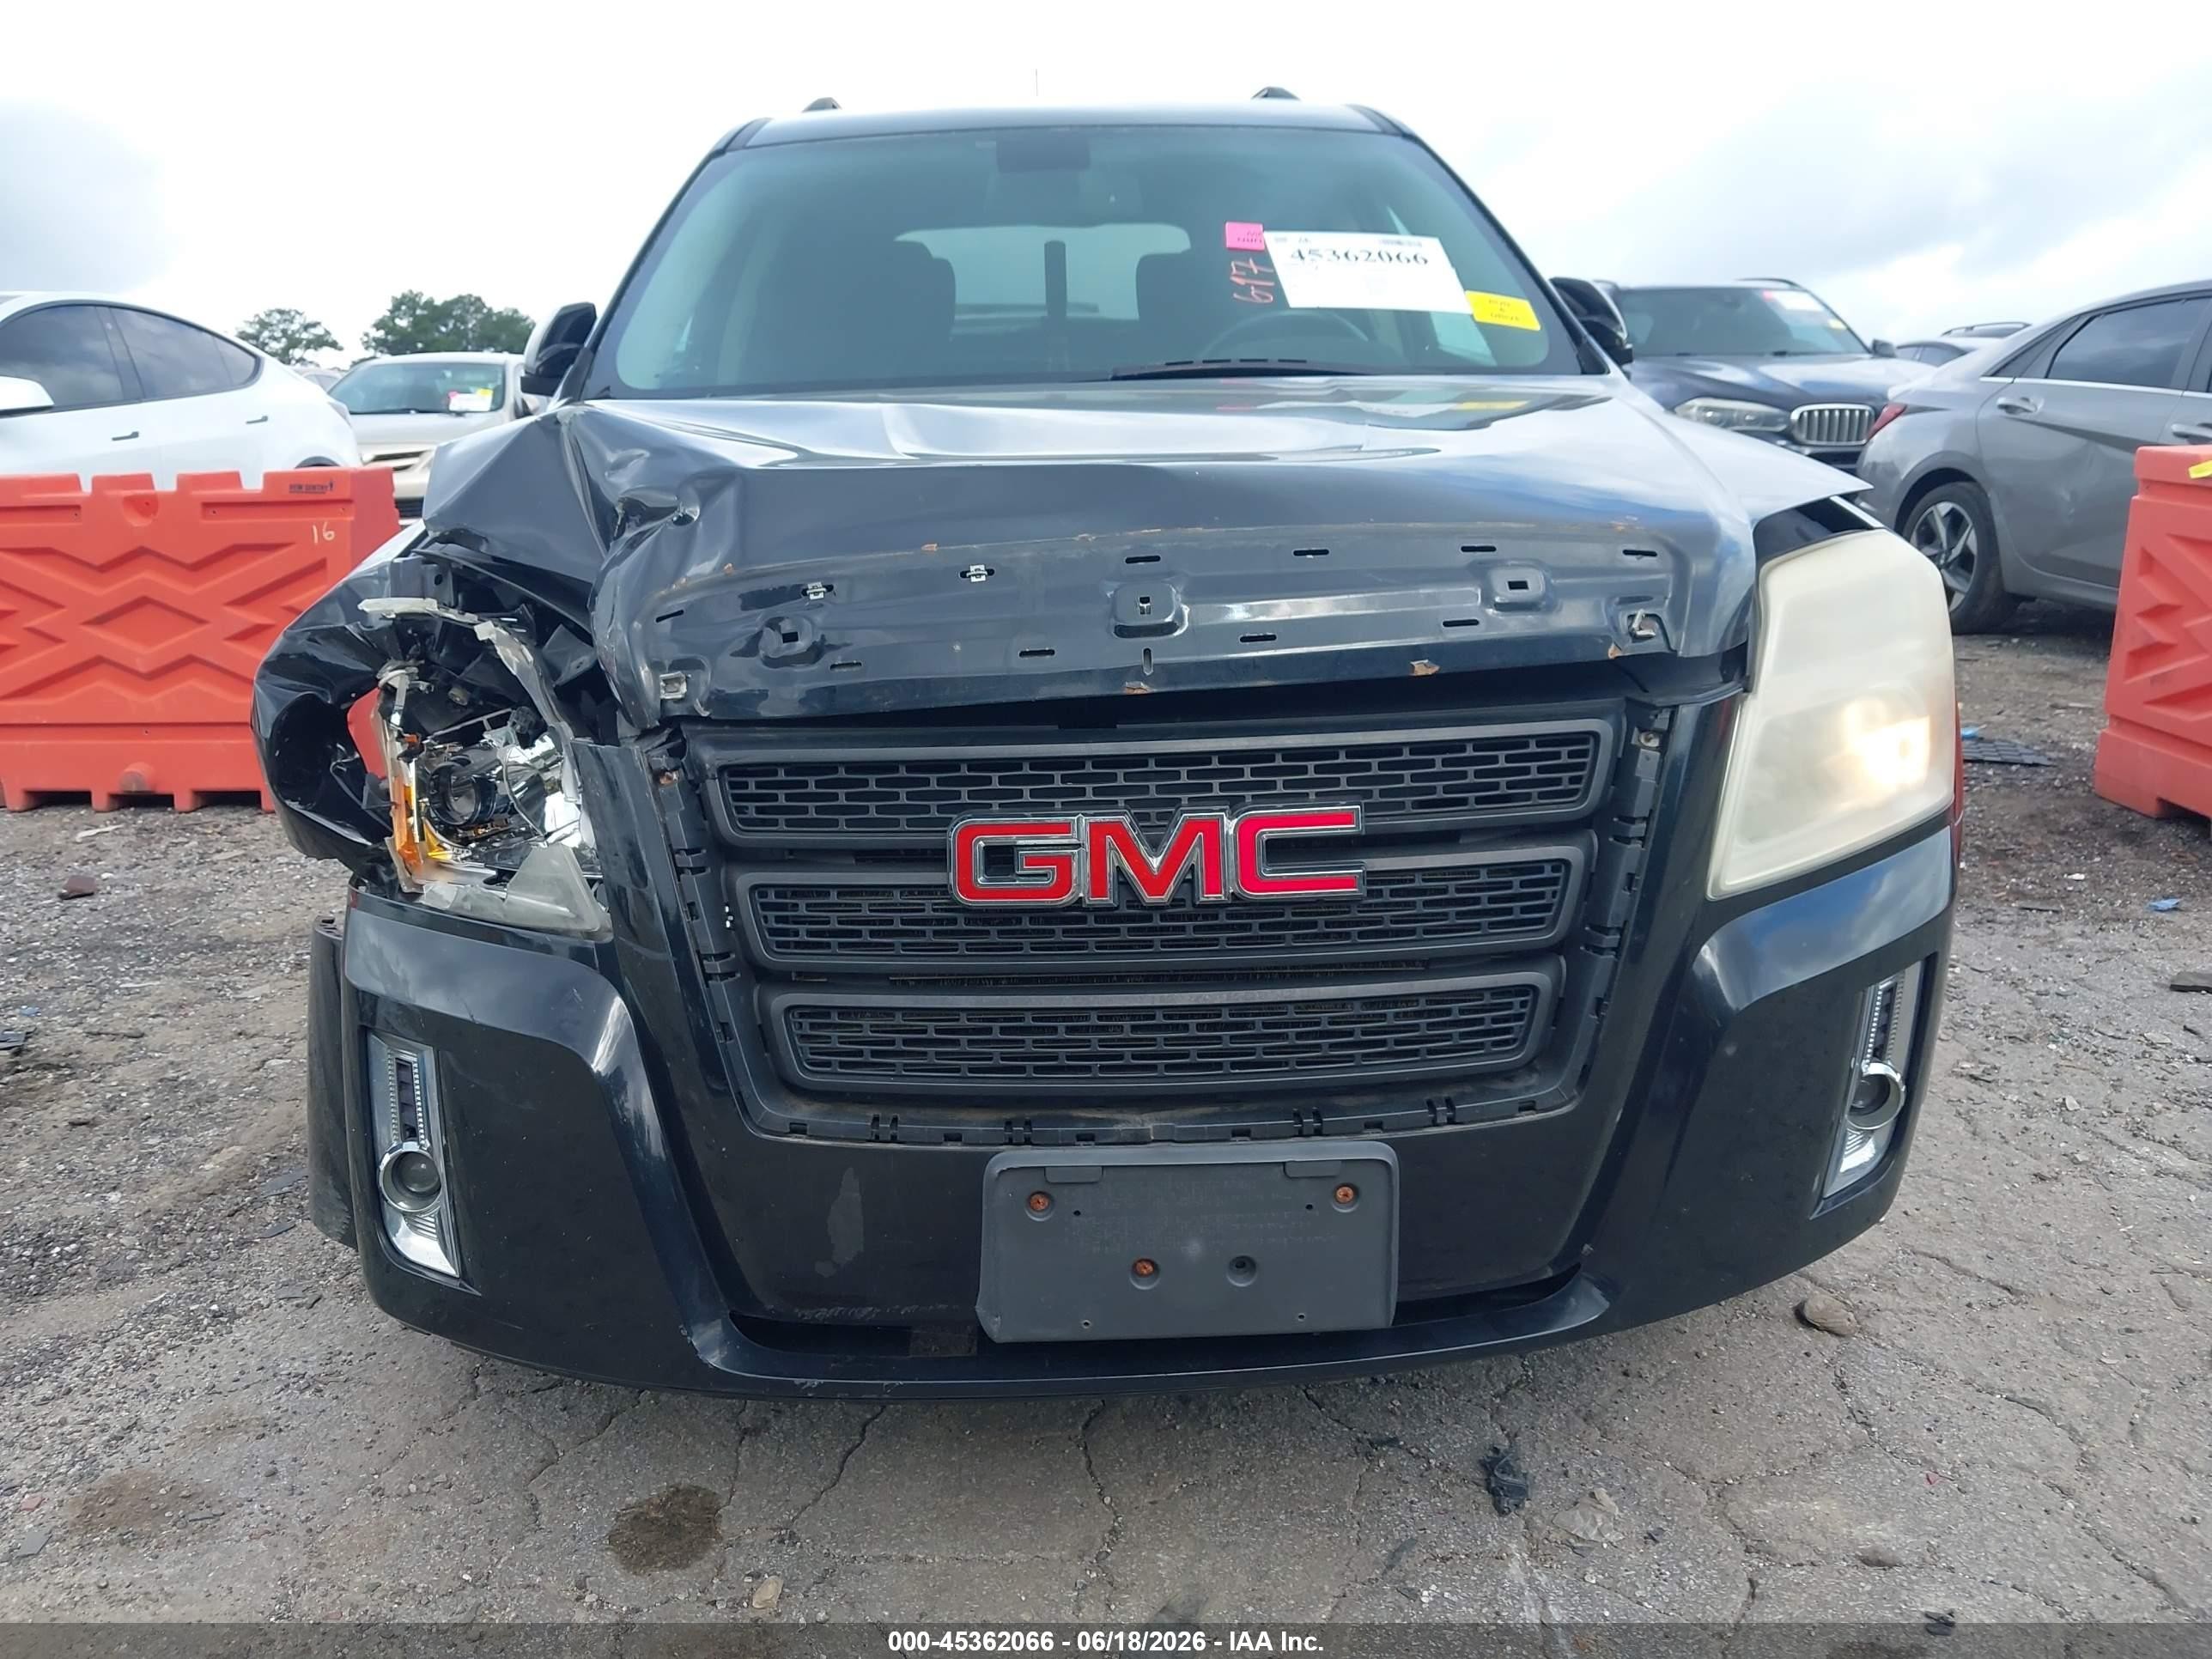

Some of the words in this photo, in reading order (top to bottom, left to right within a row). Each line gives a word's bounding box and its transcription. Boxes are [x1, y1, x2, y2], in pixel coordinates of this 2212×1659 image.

[1291, 248, 1429, 265] 45362066
[312, 521, 336, 544] 16
[951, 805, 1366, 907] GMC
